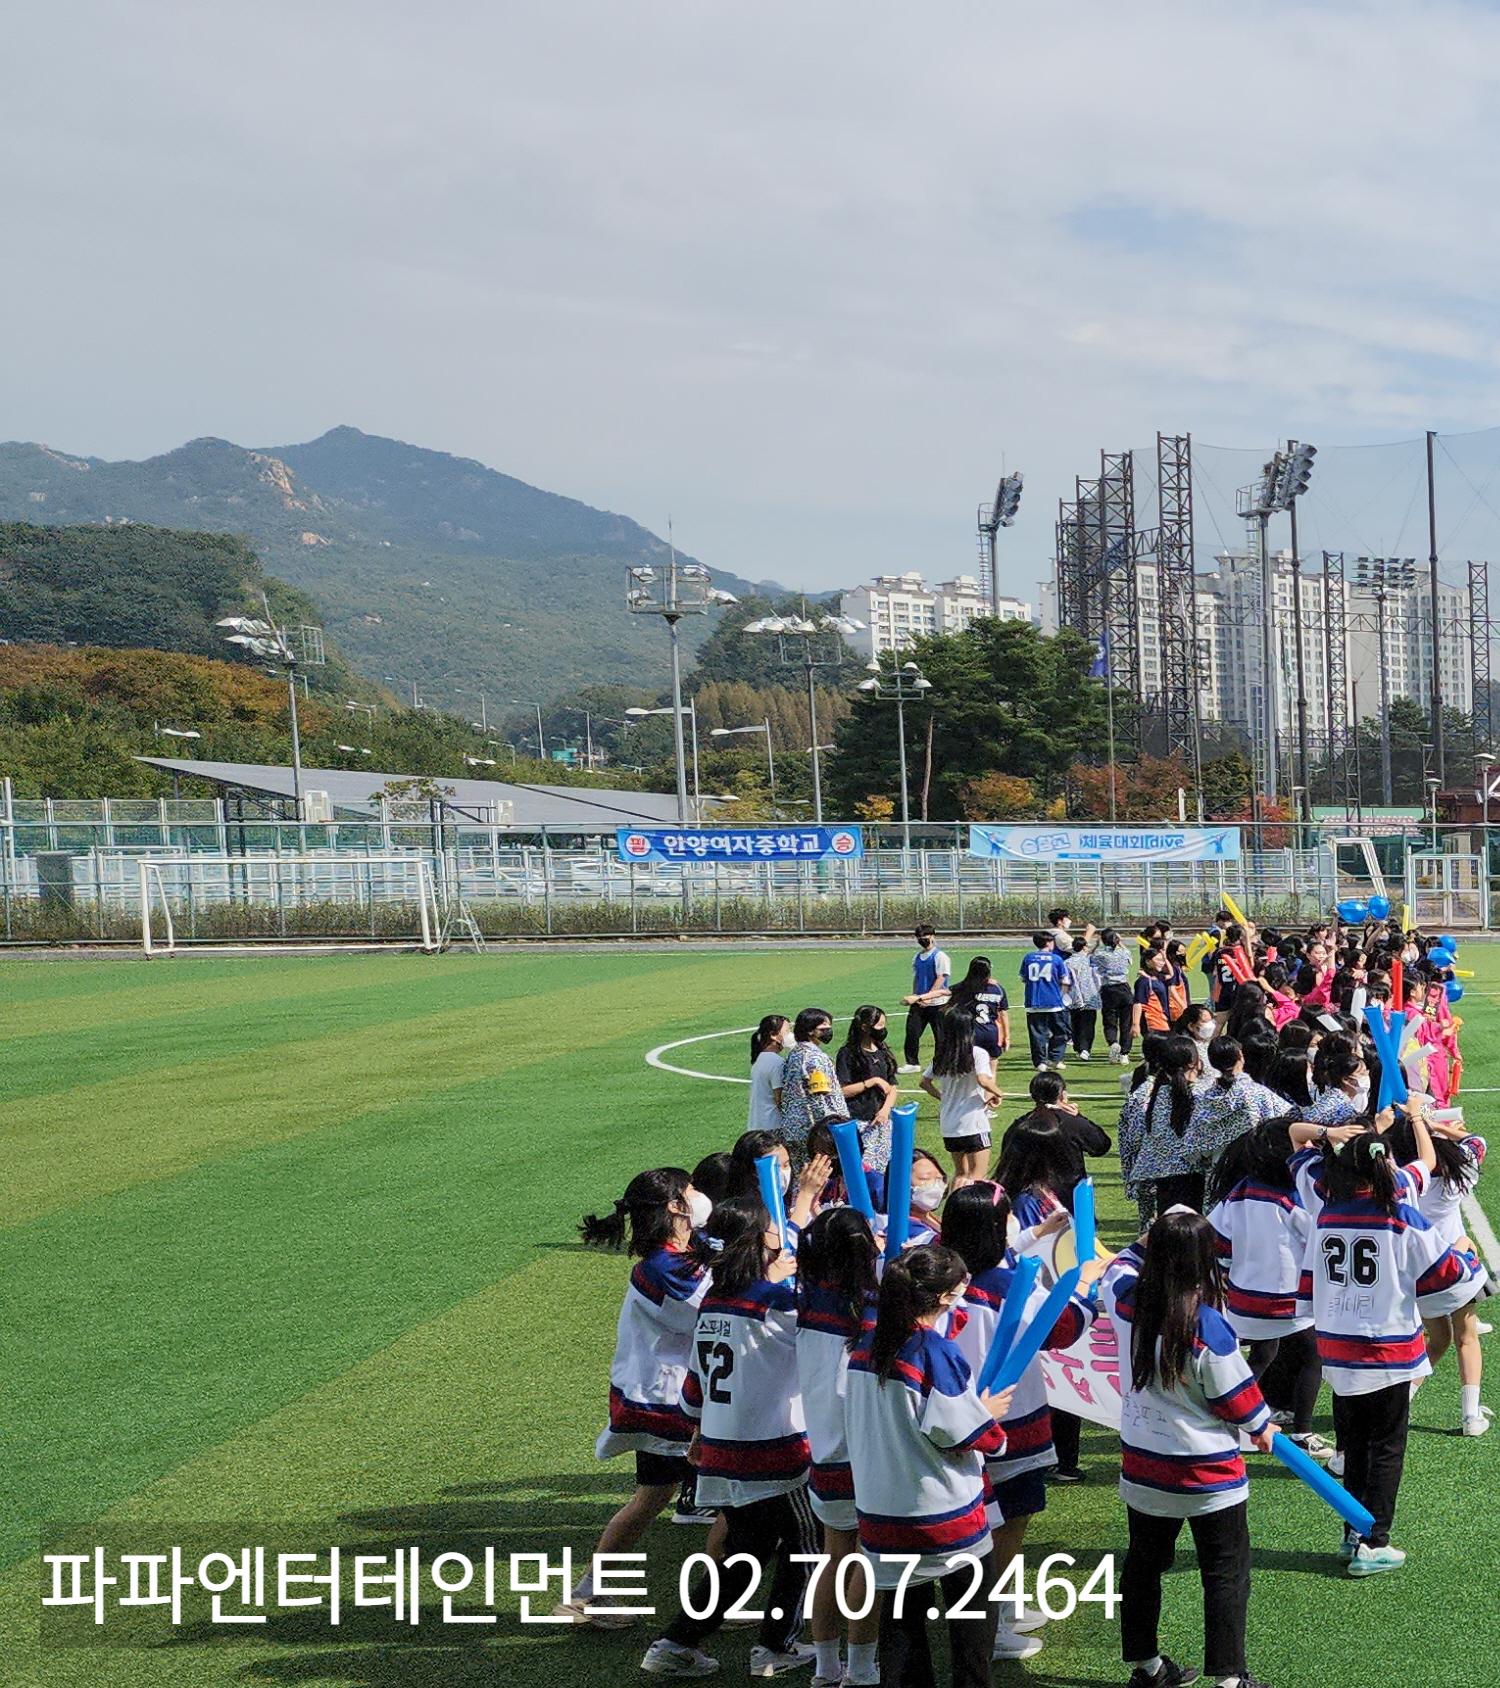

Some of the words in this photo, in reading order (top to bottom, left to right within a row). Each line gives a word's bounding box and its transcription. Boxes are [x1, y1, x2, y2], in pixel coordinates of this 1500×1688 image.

[663, 834, 822, 856] 안양여자중학교
[1027, 962, 1053, 983] 04
[1321, 1233, 1380, 1289] 26
